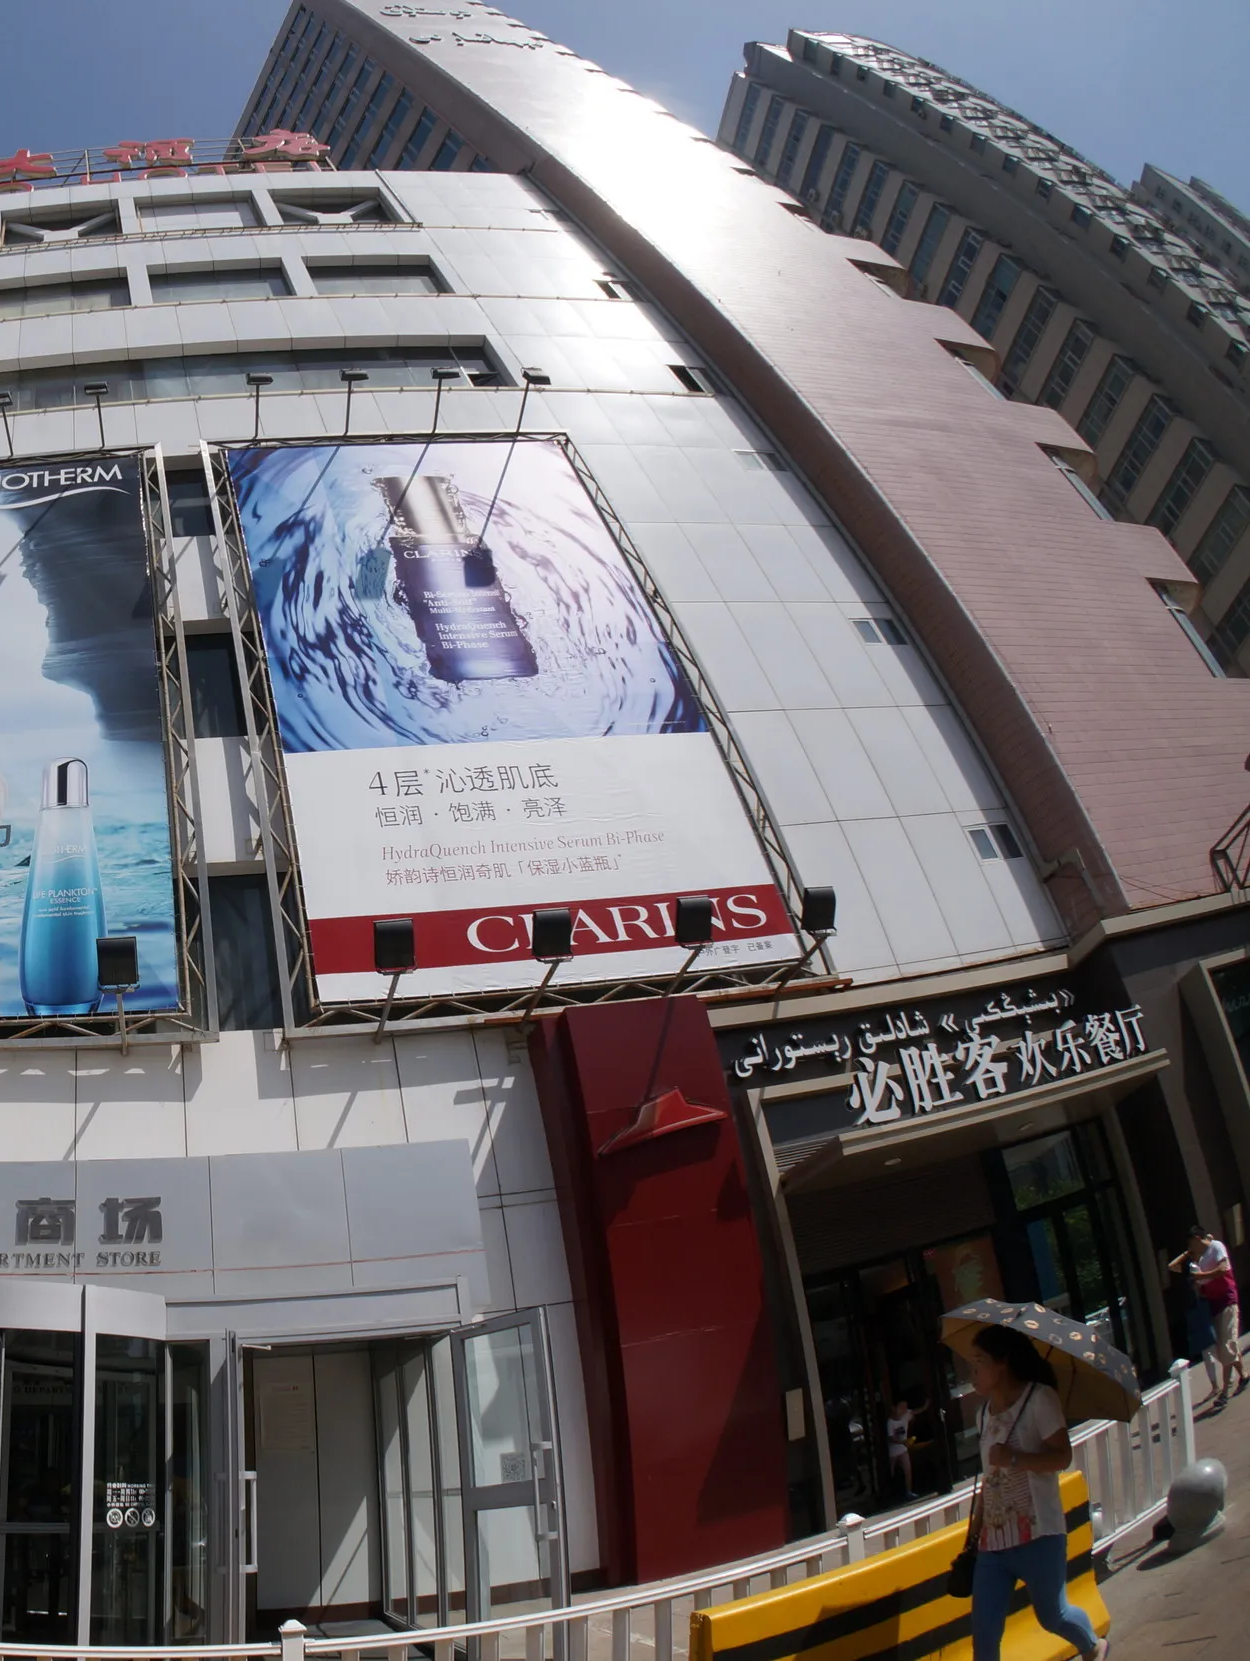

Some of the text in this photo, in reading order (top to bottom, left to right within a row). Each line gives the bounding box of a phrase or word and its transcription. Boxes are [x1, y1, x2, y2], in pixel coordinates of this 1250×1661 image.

[382, 830, 665, 864] HydraQuench Intensive Serum Bi-Phase
[96, 1250, 162, 1267] STORE
